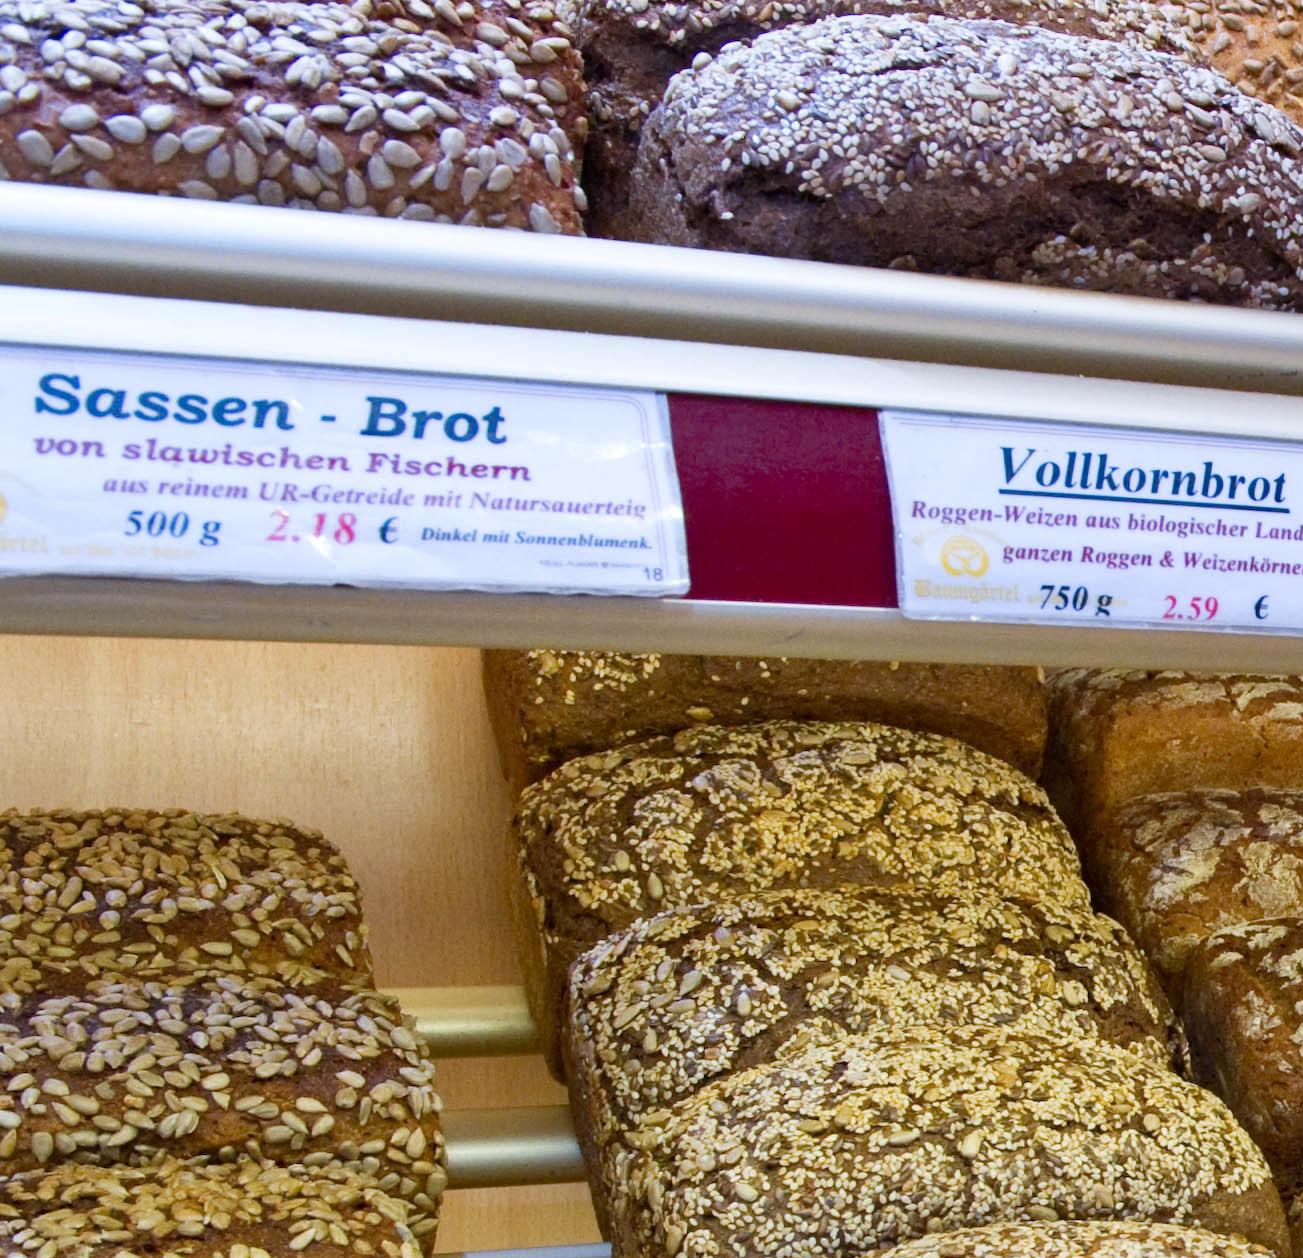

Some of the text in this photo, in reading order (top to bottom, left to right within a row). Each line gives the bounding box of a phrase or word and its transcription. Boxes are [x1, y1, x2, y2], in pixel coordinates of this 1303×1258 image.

[35, 373, 295, 430] Sassen
[360, 396, 507, 444] Brot
[34, 437, 532, 482] von slawischen Fischern
[1000, 447, 1287, 503] Vollkornbrot
[103, 478, 647, 519] aus reinem UR-Getreide mit Natursauerteig
[124, 509, 401, 547] 500 g 2.18 €
[421, 527, 653, 550] Dinkel mit Sonnenblumenk.
[911, 501, 1078, 528] Roggen-Weizen
[1086, 515, 1121, 530] aus
[1128, 513, 1248, 539] biologischer
[643, 567, 665, 581] 18
[1003, 545, 1073, 563] ganzen
[1081, 546, 1153, 570] Roggen
[1159, 550, 1175, 568] &
[1040, 584, 1089, 612] 750
[1095, 592, 1113, 617] g
[1163, 594, 1219, 621] 2.59
[1254, 595, 1270, 620] €
